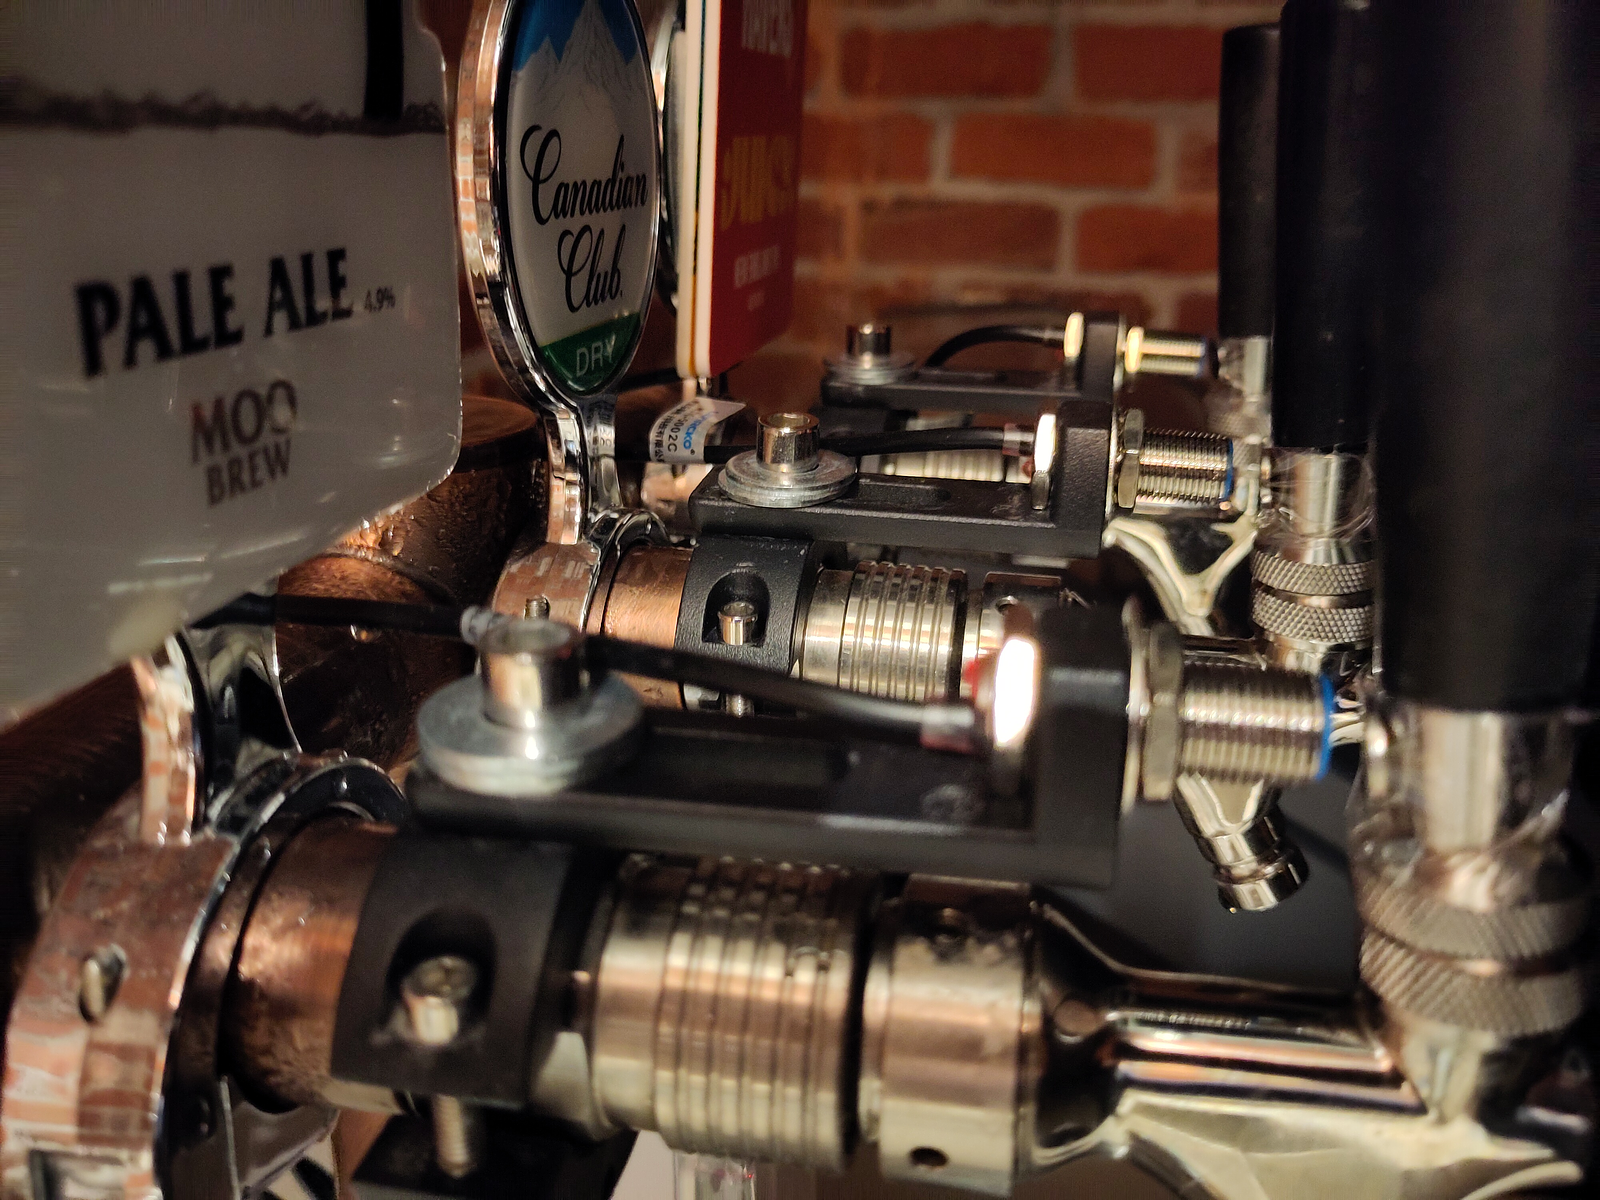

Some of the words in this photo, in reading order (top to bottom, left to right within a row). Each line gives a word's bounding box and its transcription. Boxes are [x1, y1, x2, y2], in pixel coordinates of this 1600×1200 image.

[520, 124, 648, 225] Canadian
[75, 263, 245, 378] PALE
[264, 247, 354, 338] ALE
[364, 286, 397, 314] 4.9%
[576, 333, 616, 377] DRY
[191, 379, 296, 466] MOO
[206, 438, 292, 507] BREW
